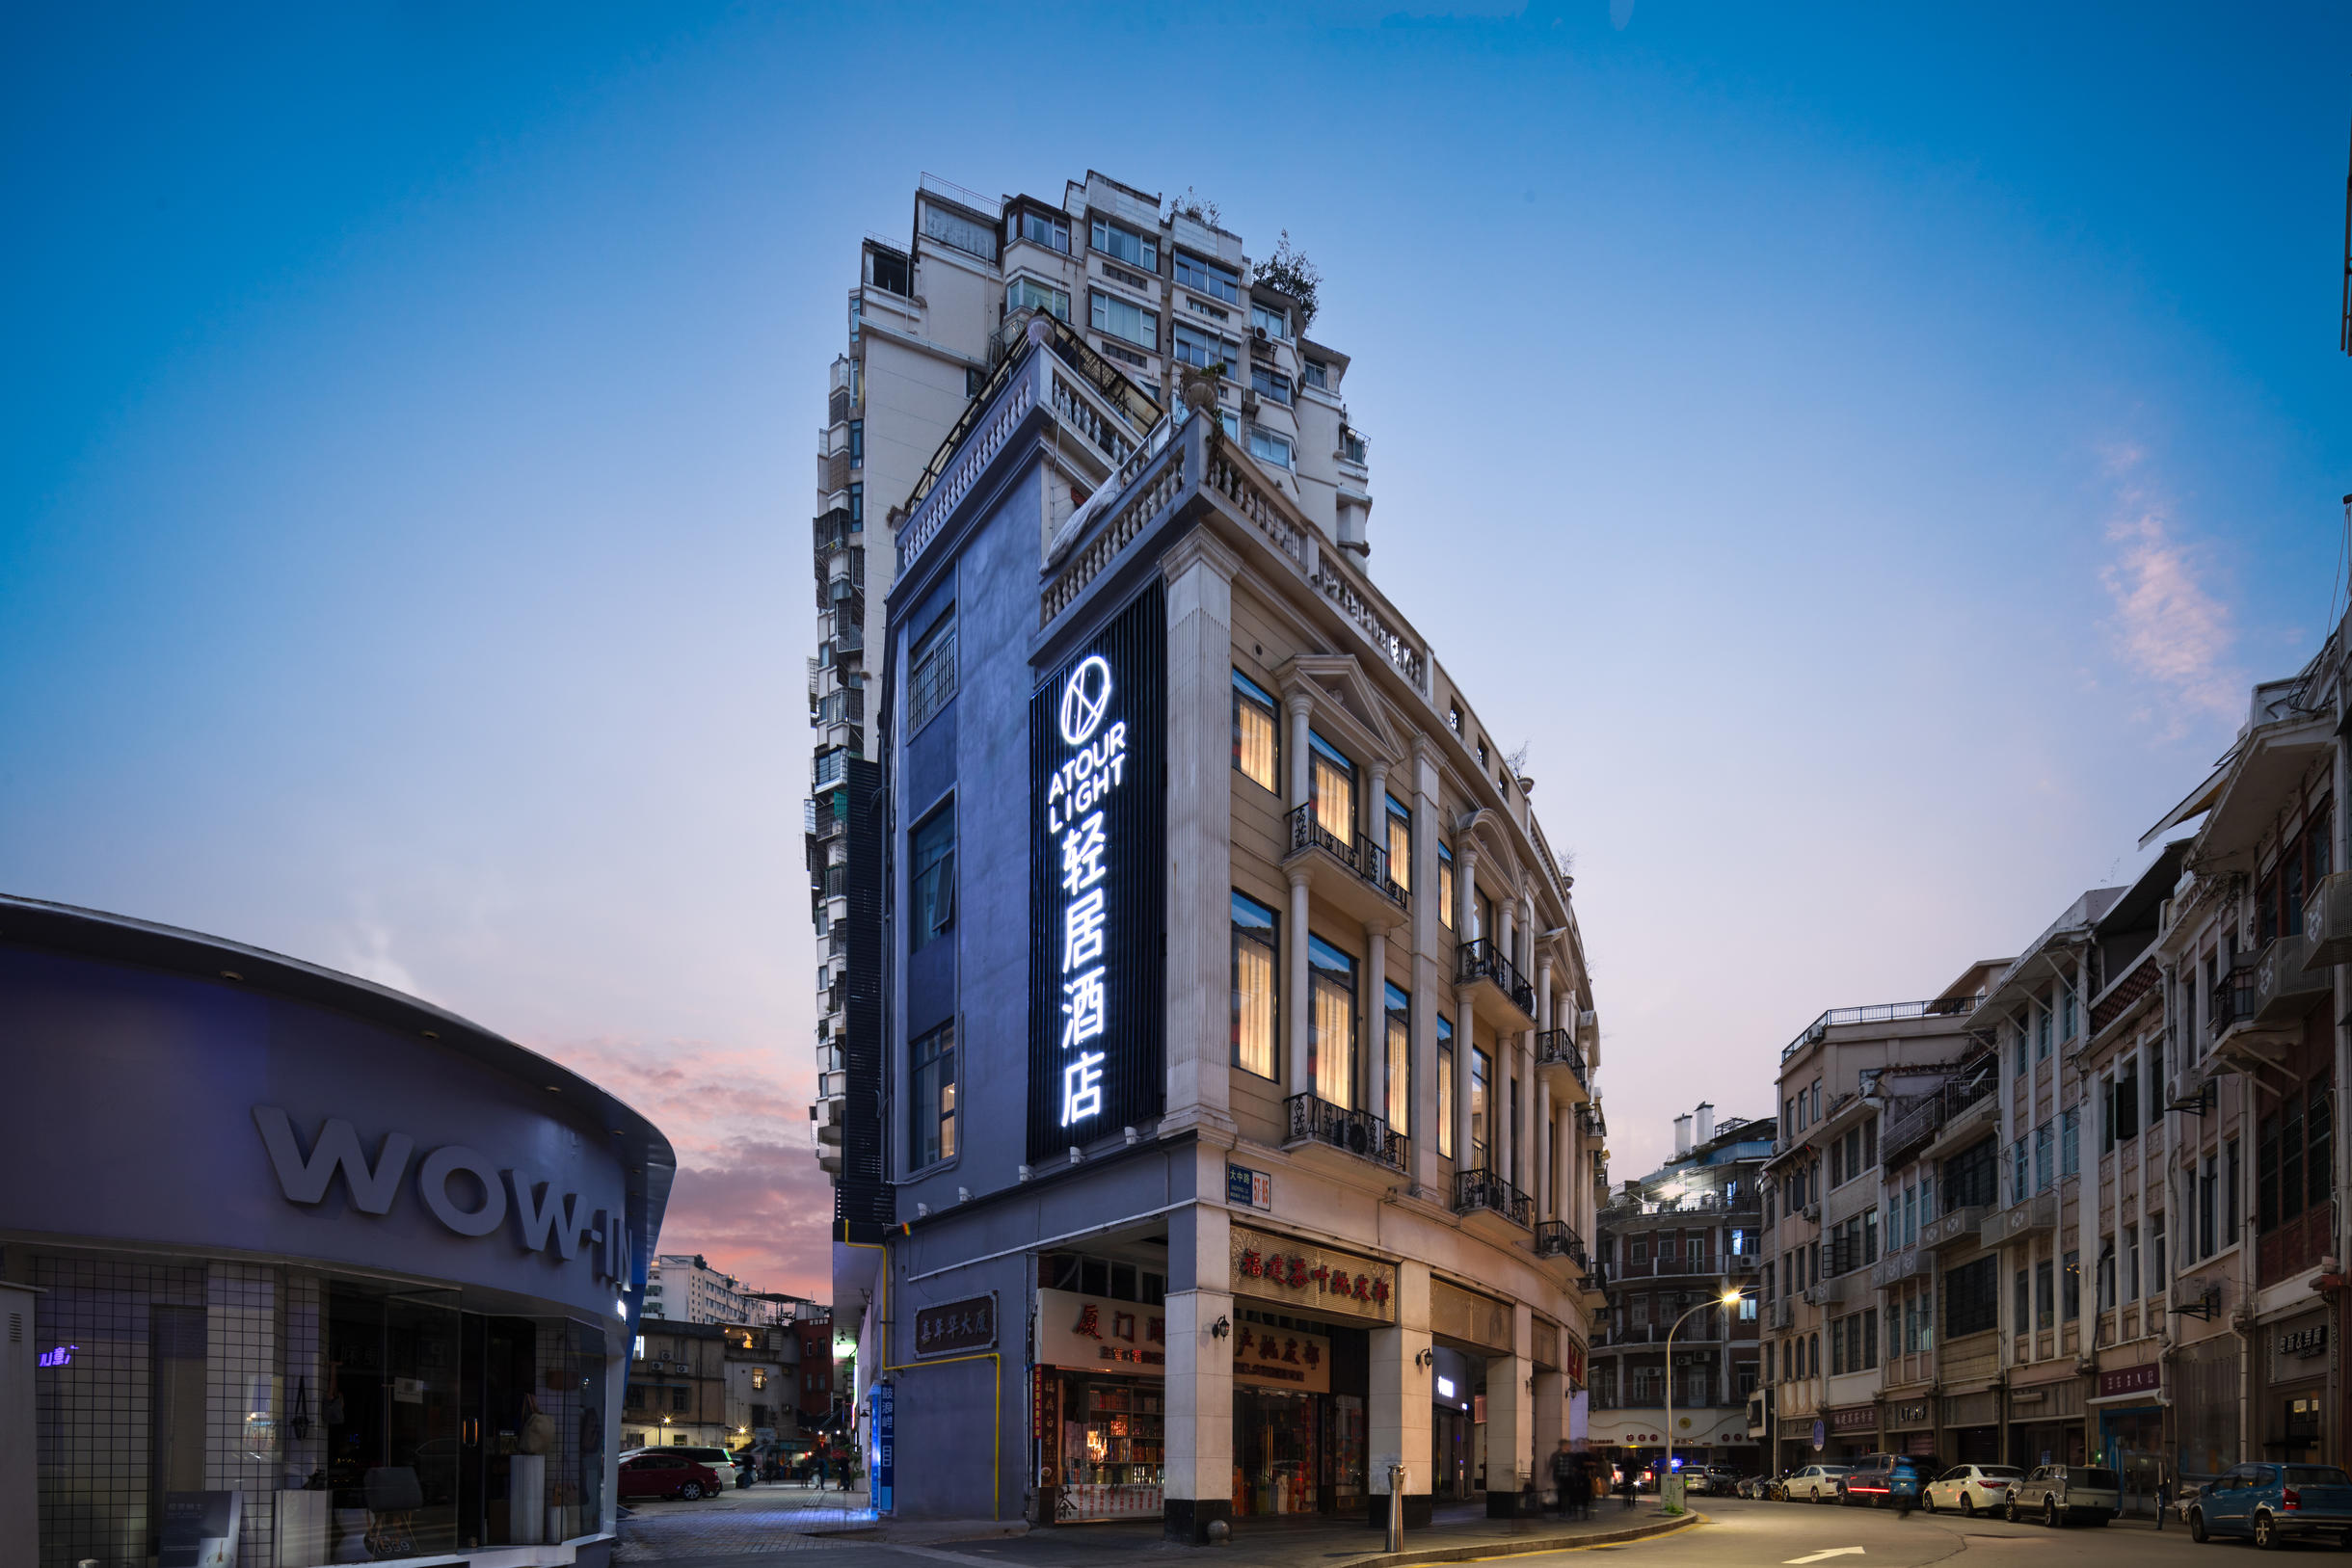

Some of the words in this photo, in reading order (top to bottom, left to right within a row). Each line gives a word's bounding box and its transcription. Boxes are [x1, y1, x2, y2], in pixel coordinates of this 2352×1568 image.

[1048, 720, 1127, 805] ATOUR
[1049, 752, 1127, 835] LIGHT
[1061, 811, 1107, 1128] 轻居酒店
[252, 1104, 632, 1292] WOW-IN
[1229, 1169, 1250, 1185] 大中路
[1241, 1249, 1390, 1307] 福建茶叶批发部
